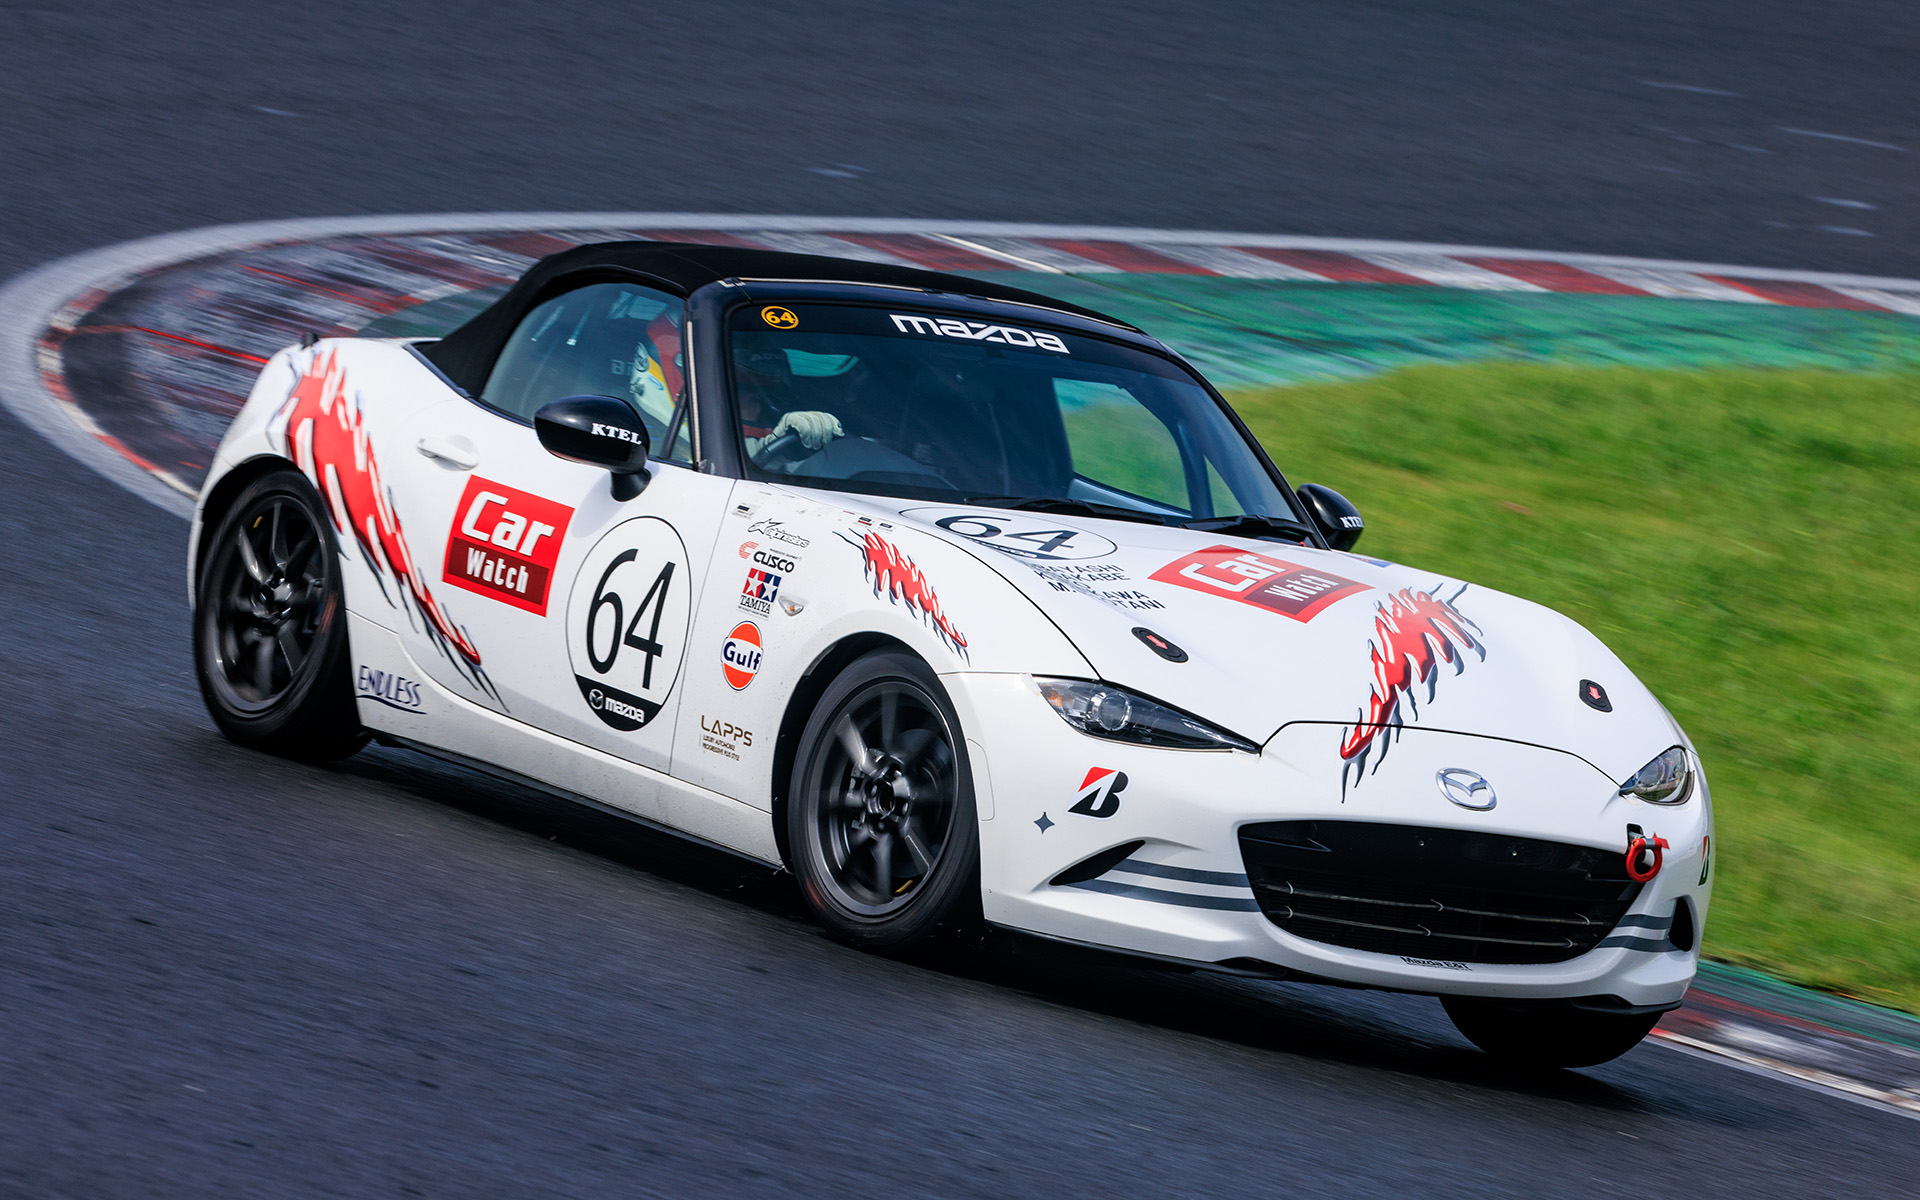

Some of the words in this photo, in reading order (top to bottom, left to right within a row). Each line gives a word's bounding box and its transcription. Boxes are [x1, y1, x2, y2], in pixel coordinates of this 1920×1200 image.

[765, 309, 795, 325] 64
[591, 423, 642, 446] KTEL
[461, 491, 555, 557] Car
[934, 515, 1079, 553] 64
[466, 547, 529, 594] Watch
[753, 550, 795, 574] CUSCO
[1179, 553, 1288, 593] Car
[1263, 573, 1340, 602] Watch
[586, 548, 676, 690] 64
[740, 594, 770, 615] TAMIYA
[723, 641, 761, 670] Gulf
[358, 664, 421, 707] ENDLESS
[604, 698, 645, 723] mazda
[701, 714, 753, 747] LAPPS
